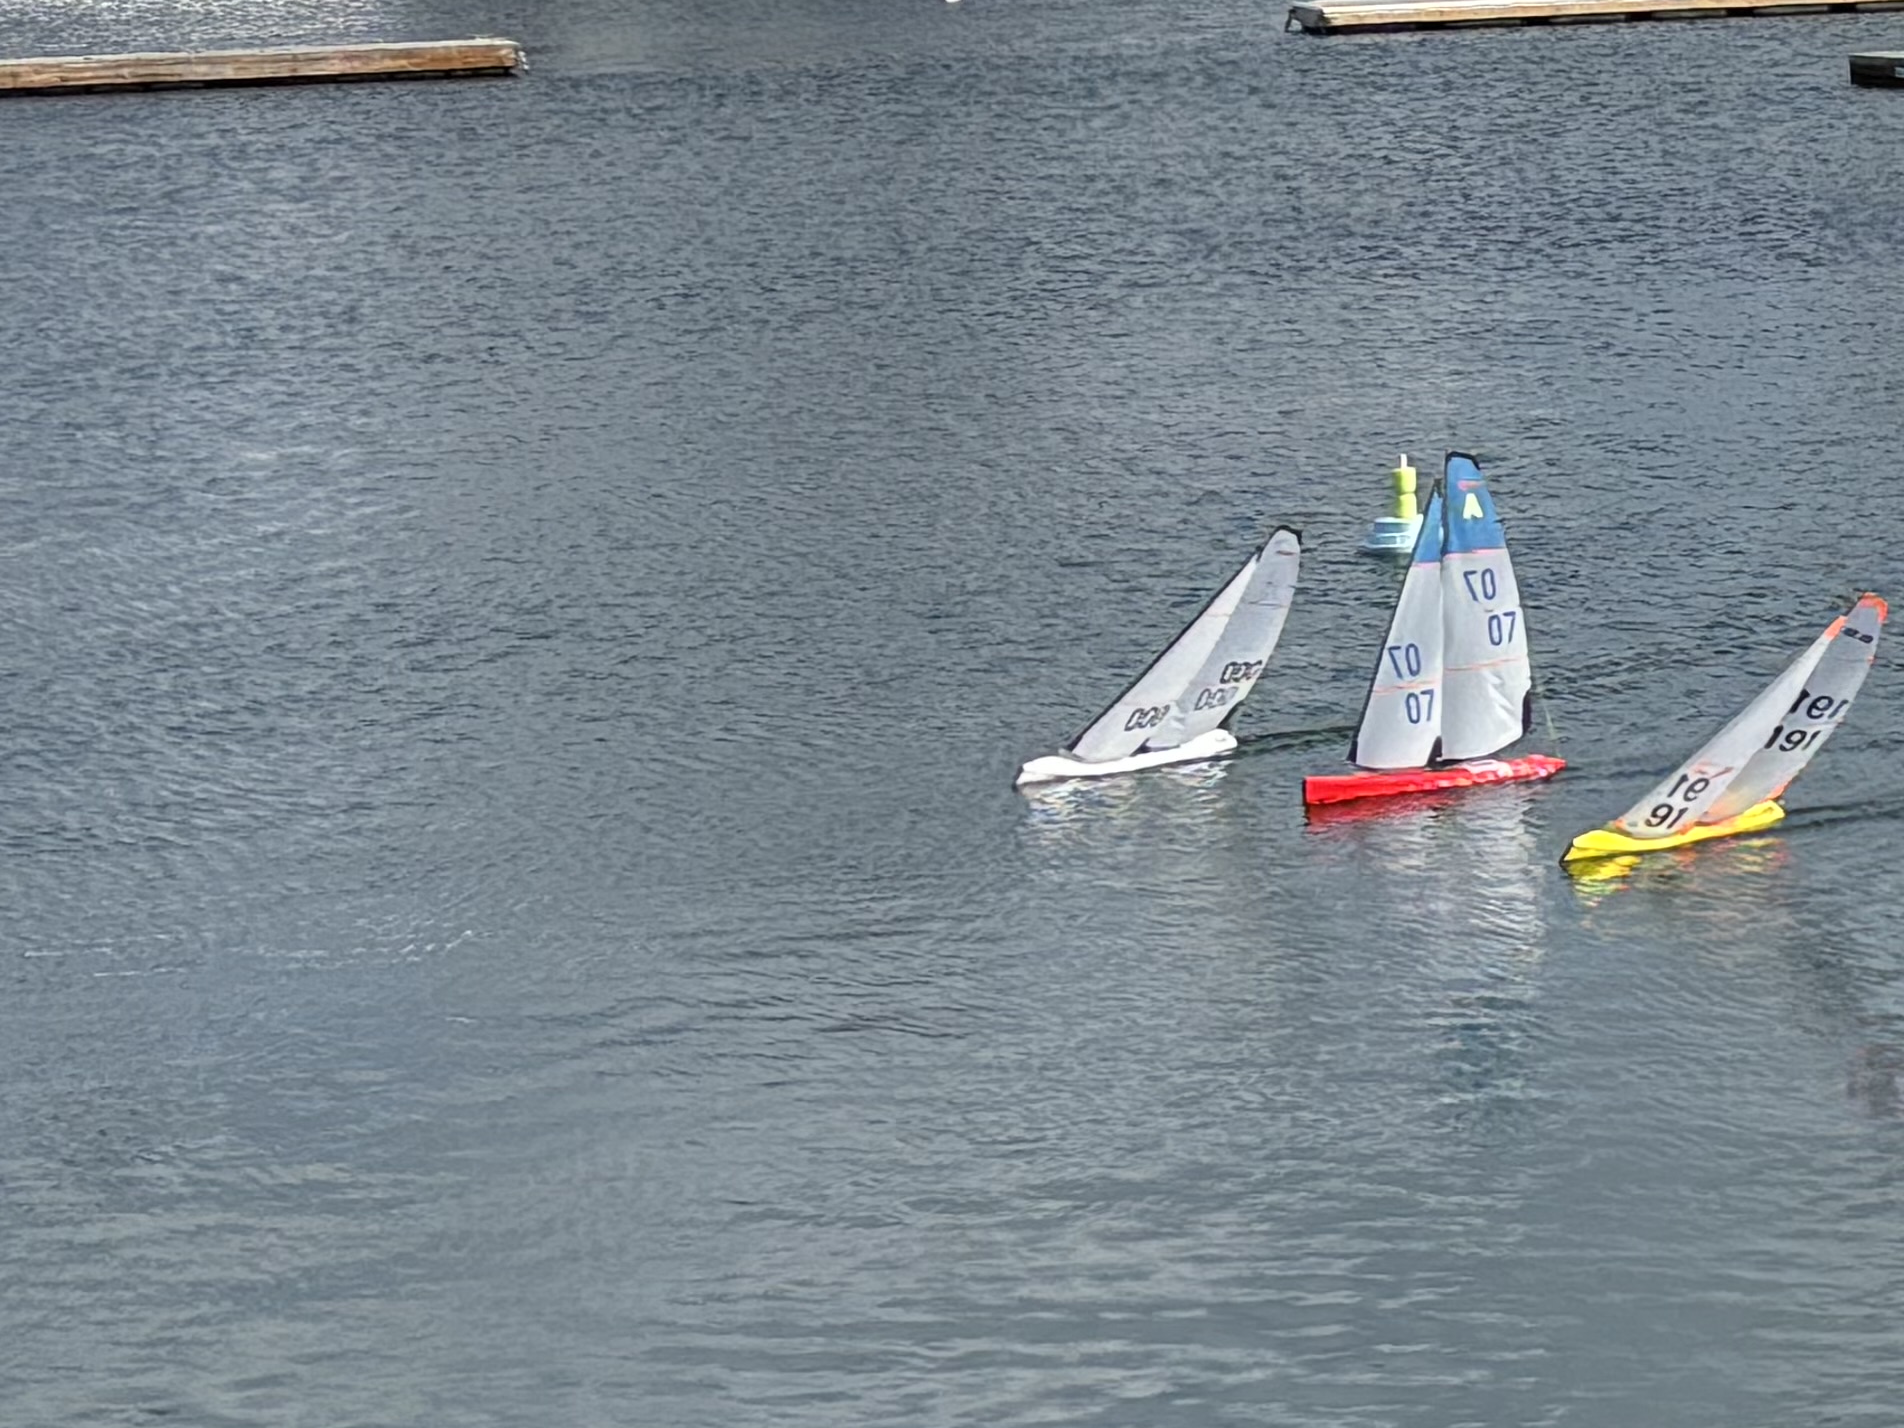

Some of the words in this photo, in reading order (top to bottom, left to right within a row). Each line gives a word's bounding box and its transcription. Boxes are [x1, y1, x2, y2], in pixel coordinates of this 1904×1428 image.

[1487, 610, 1517, 646] 07
[1404, 687, 1435, 724] 07
[1644, 803, 1689, 829] 91
